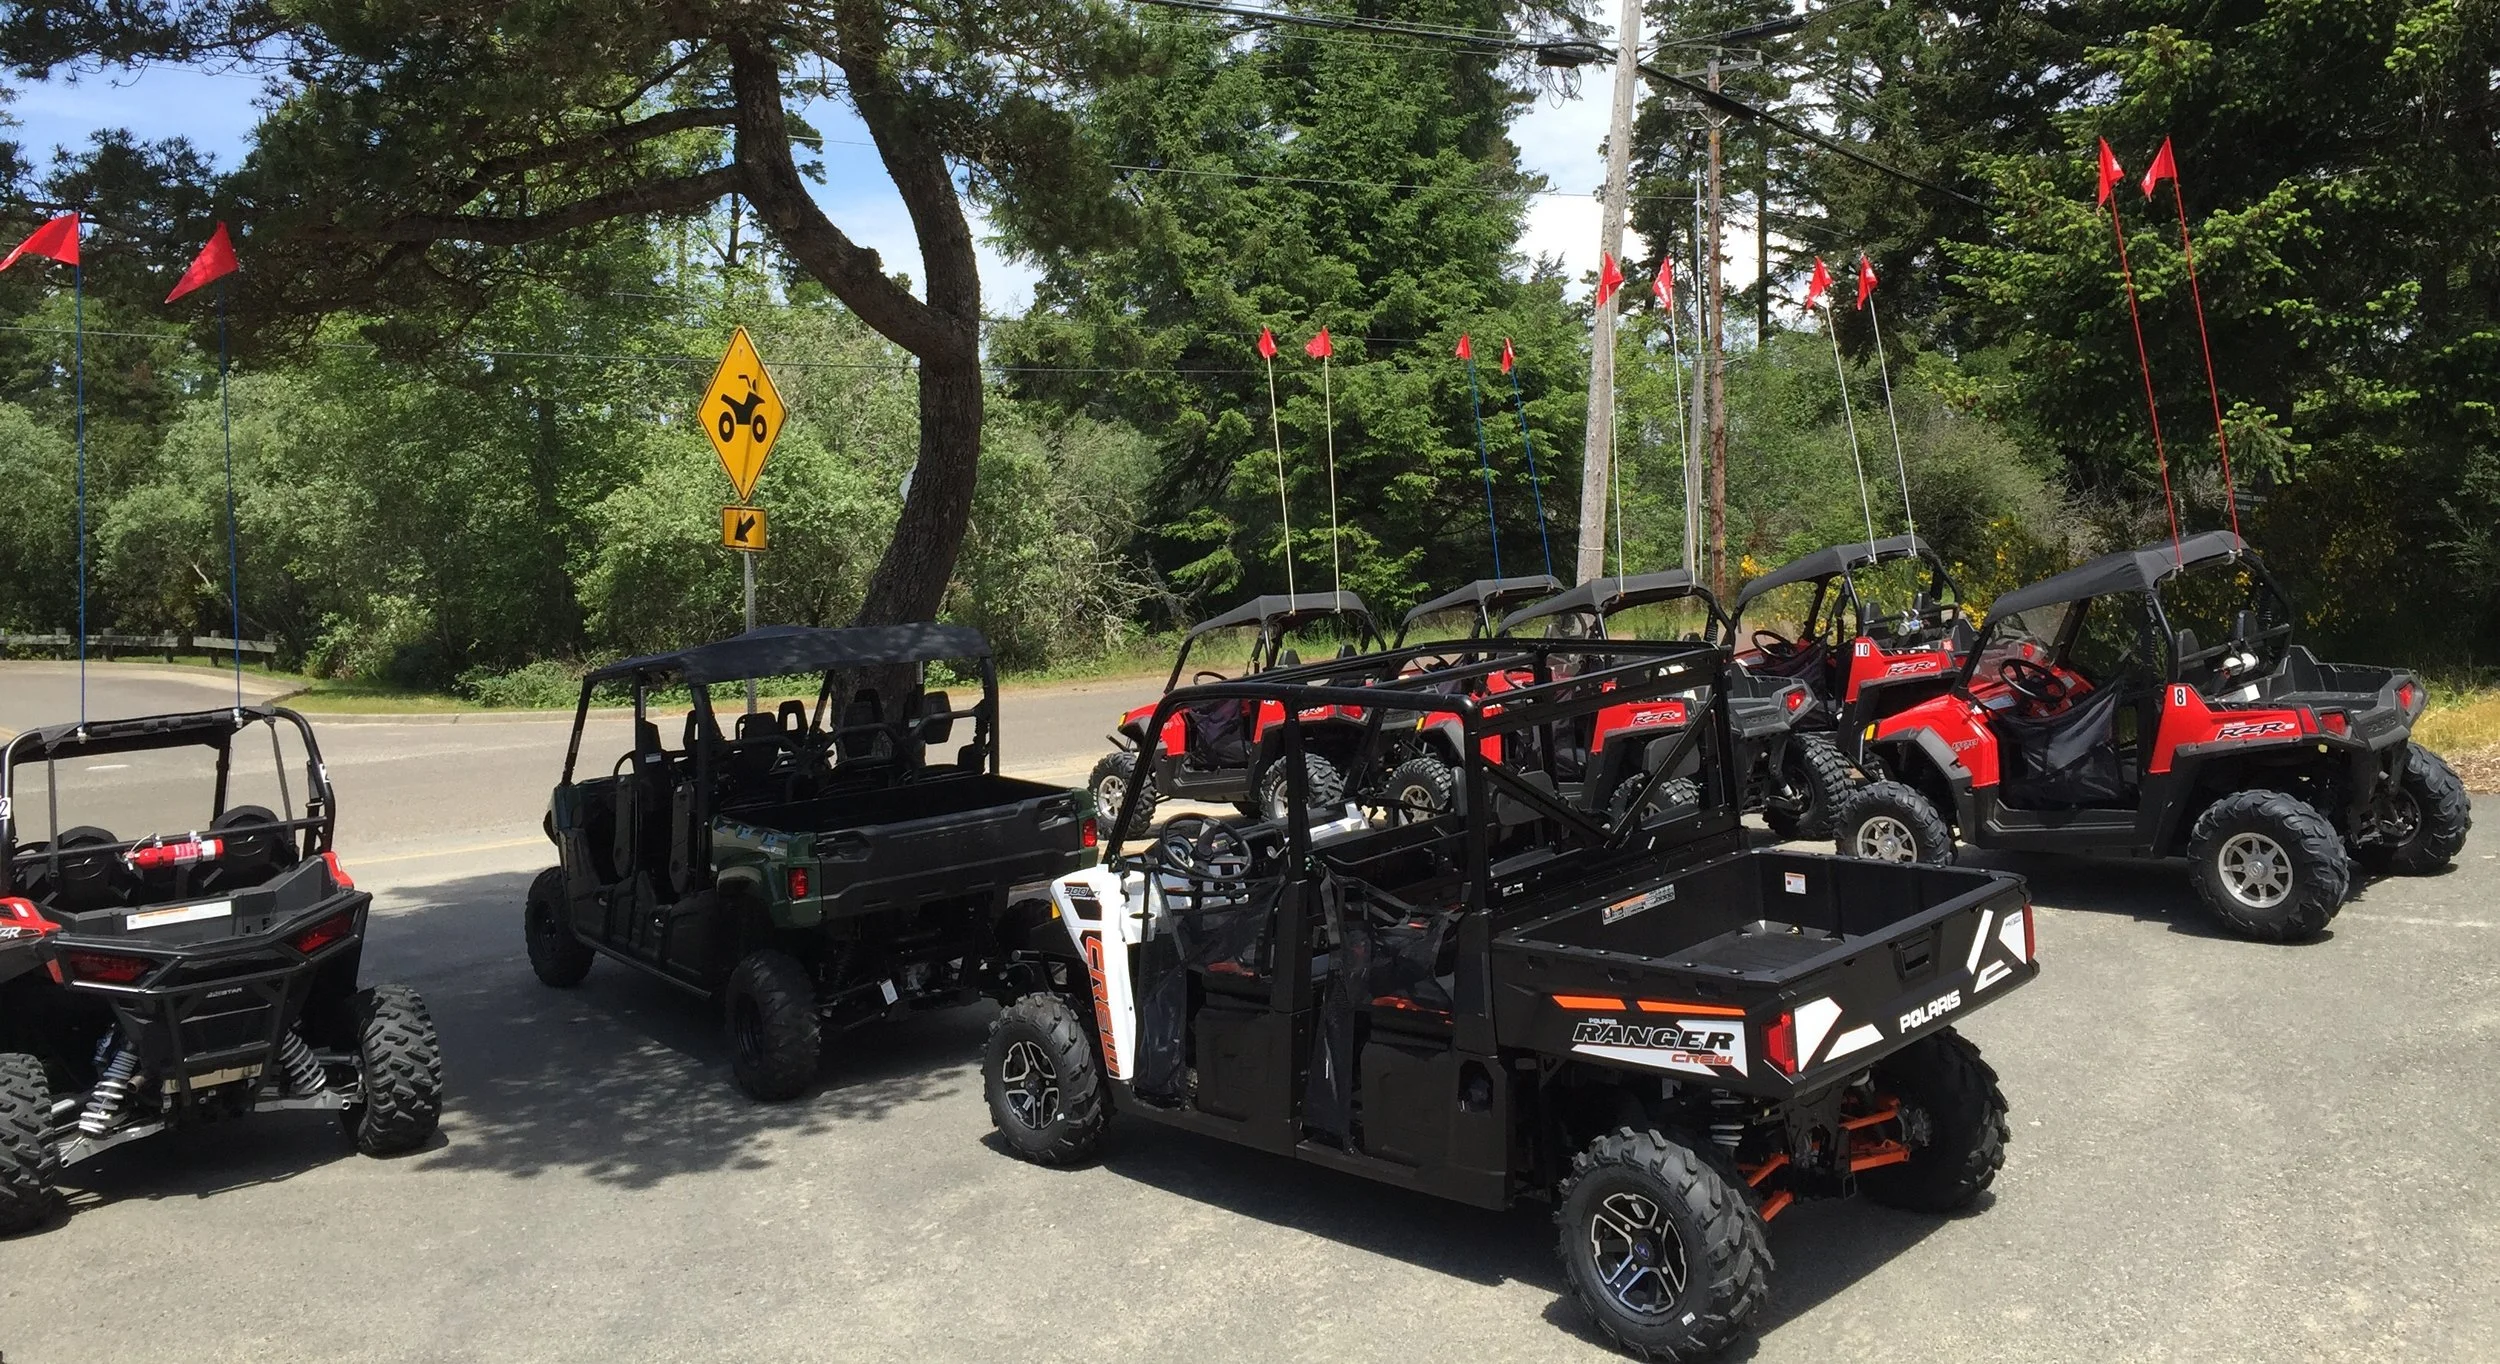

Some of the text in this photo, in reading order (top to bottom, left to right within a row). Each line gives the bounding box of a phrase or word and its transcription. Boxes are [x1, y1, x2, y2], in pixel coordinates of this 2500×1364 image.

[1857, 644, 1869, 656] 10
[2176, 688, 2184, 705] 8
[2215, 721, 2286, 740] RZR
[1064, 886, 1089, 898] 900
[1086, 936, 1122, 1078] CREW
[1899, 989, 1961, 1034] POLARIS
[1572, 1022, 1736, 1051] RANGER
[1671, 1054, 1734, 1066] CREW
